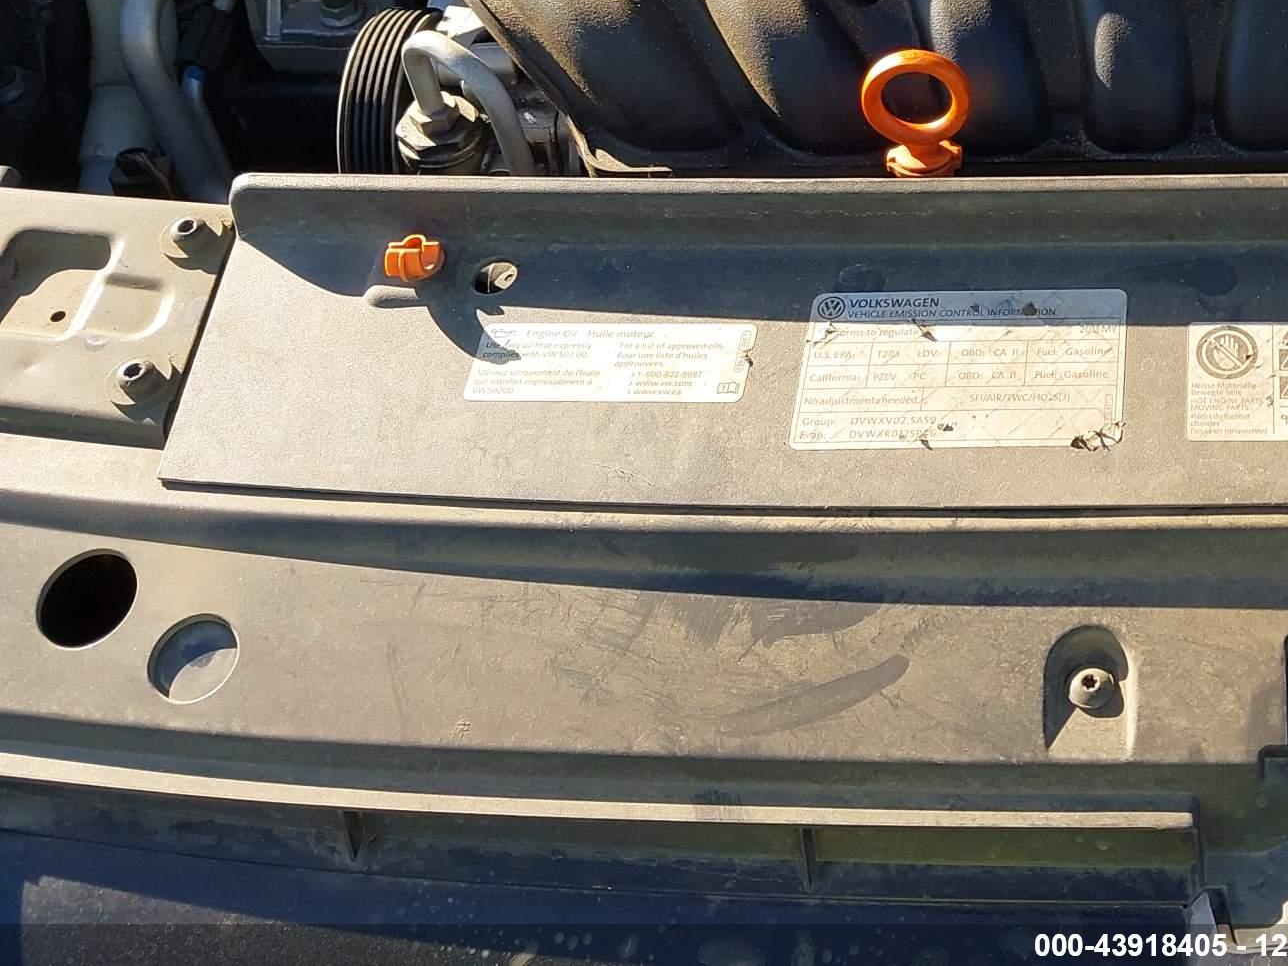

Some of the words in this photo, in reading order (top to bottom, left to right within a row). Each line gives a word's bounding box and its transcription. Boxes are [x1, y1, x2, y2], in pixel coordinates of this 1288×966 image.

[850, 297, 940, 309] VOLKSWAGEN
[848, 309, 889, 318] VEHICLE
[890, 308, 937, 318] EMISSION
[987, 306, 1056, 317] INFORMION
[527, 329, 561, 339] Engine
[563, 329, 578, 337] Oil
[588, 329, 614, 338] Huile
[616, 329, 654, 339] moteur
[486, 341, 501, 349] Use
[1064, 347, 1113, 357] Gasoline
[1064, 370, 1109, 379] Gasoline
